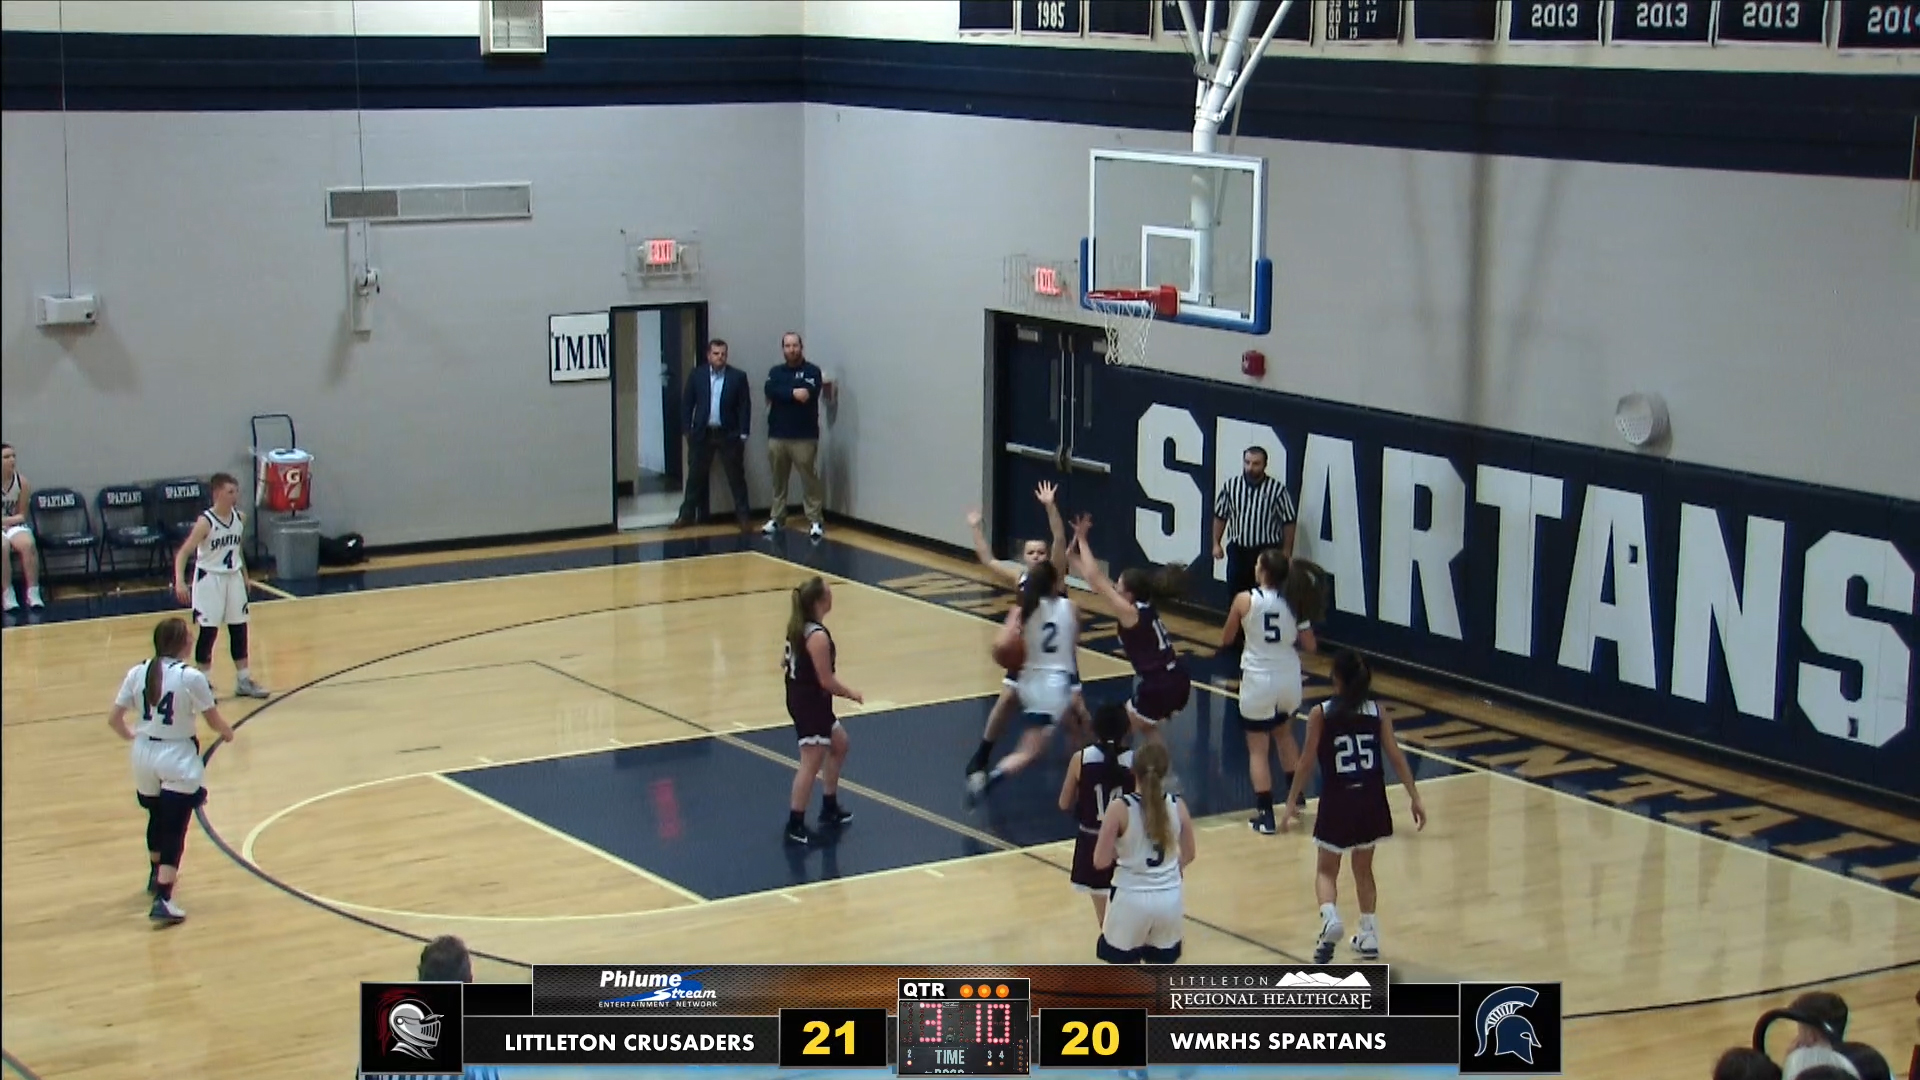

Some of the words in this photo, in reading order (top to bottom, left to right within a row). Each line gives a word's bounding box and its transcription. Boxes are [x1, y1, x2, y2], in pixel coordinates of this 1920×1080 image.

[1036, 2, 1066, 30] 1985
[1366, 10, 1377, 23] 17
[1531, 3, 1579, 28] 2013
[1636, 3, 1688, 28] 2013
[1742, 2, 1800, 28] 2013
[554, 333, 585, 371] I'M
[588, 333, 607, 369] IN
[286, 469, 301, 484] G
[223, 550, 233, 569] 4
[1134, 402, 1916, 747] SPARTANS
[1041, 622, 1057, 653] 2
[1264, 613, 1281, 643] 5
[1334, 734, 1374, 773] 25
